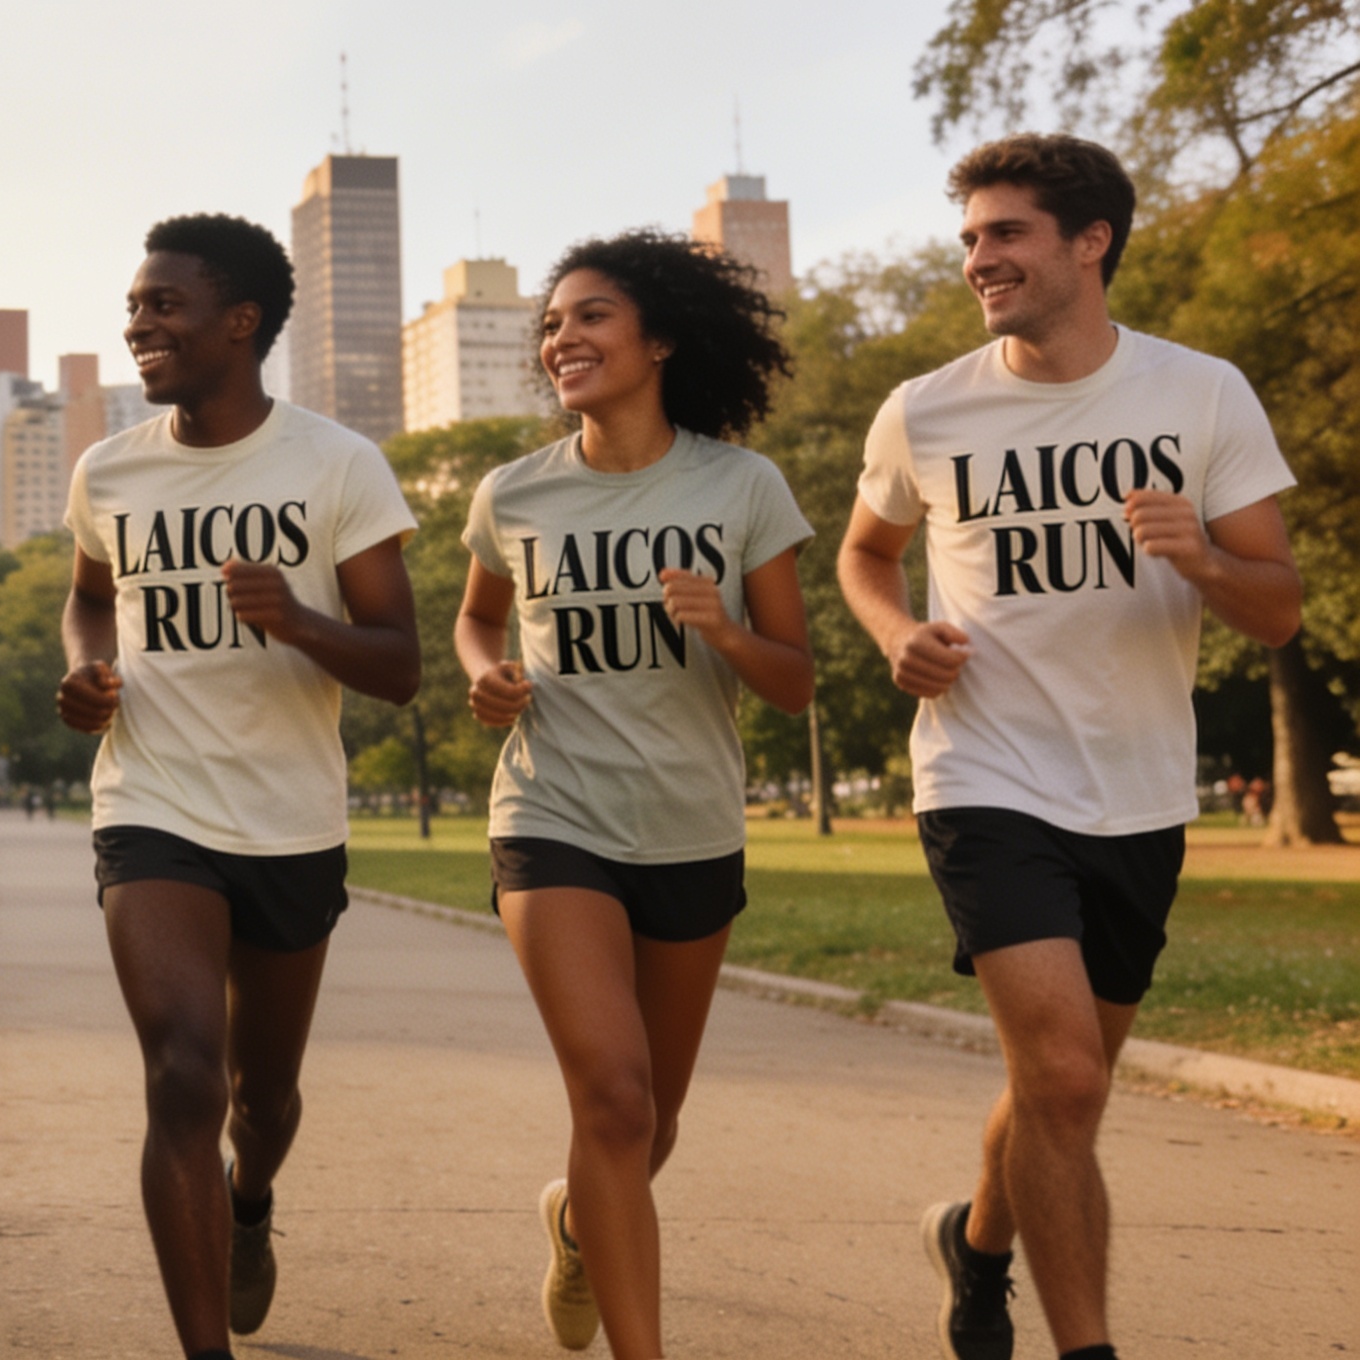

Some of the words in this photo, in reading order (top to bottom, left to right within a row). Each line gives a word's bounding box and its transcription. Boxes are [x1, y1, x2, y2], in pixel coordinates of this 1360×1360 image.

[950, 433, 1184, 523] LAICOS
[113, 500, 309, 578] LAICOS
[521, 523, 726, 600] LAICOS
[991, 518, 1136, 597] RUN
[553, 601, 686, 675] RUN
